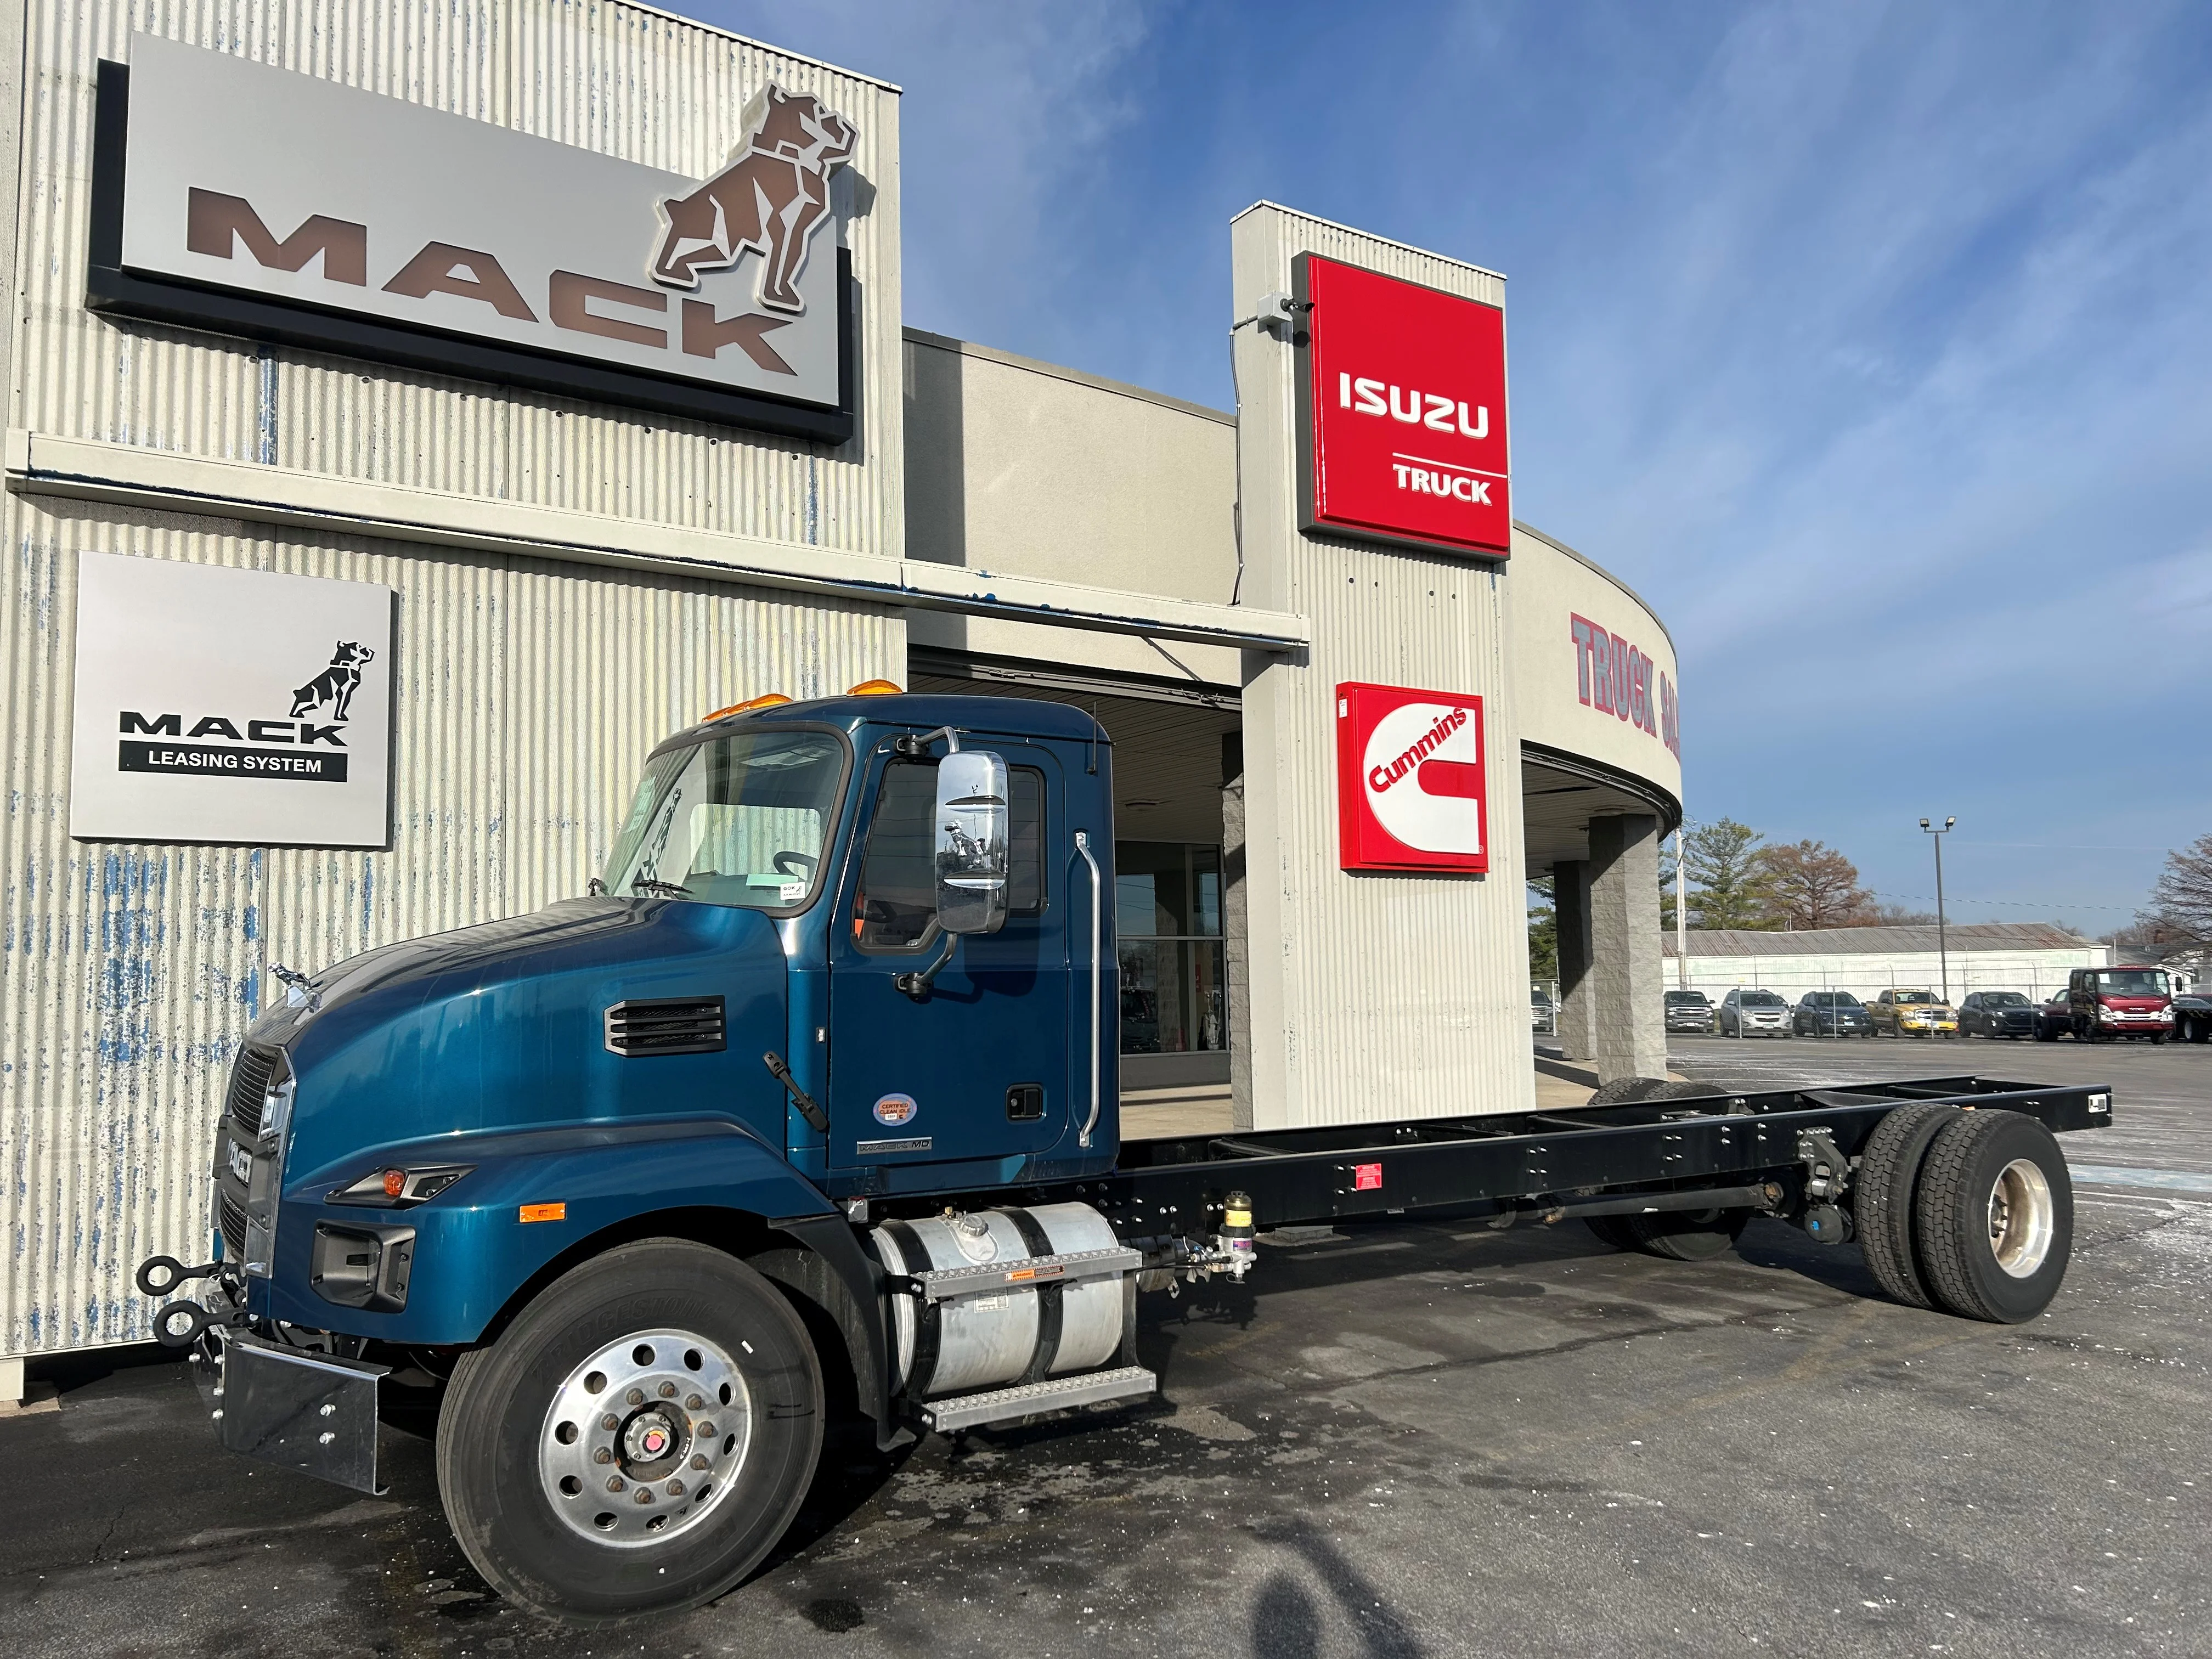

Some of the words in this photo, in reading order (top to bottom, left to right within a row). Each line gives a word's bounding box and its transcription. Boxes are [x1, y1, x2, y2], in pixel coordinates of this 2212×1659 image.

[188, 187, 798, 376] MACK
[1339, 371, 1489, 439] ISUZU
[1392, 463, 1493, 506] TRUCK
[1570, 611, 1657, 739] TRUCK
[119, 710, 348, 747] MACK
[1369, 707, 1466, 793] Cummins
[148, 749, 238, 769] LEASING
[242, 755, 321, 774] SYSTEM
[860, 1143, 908, 1151] MACK
